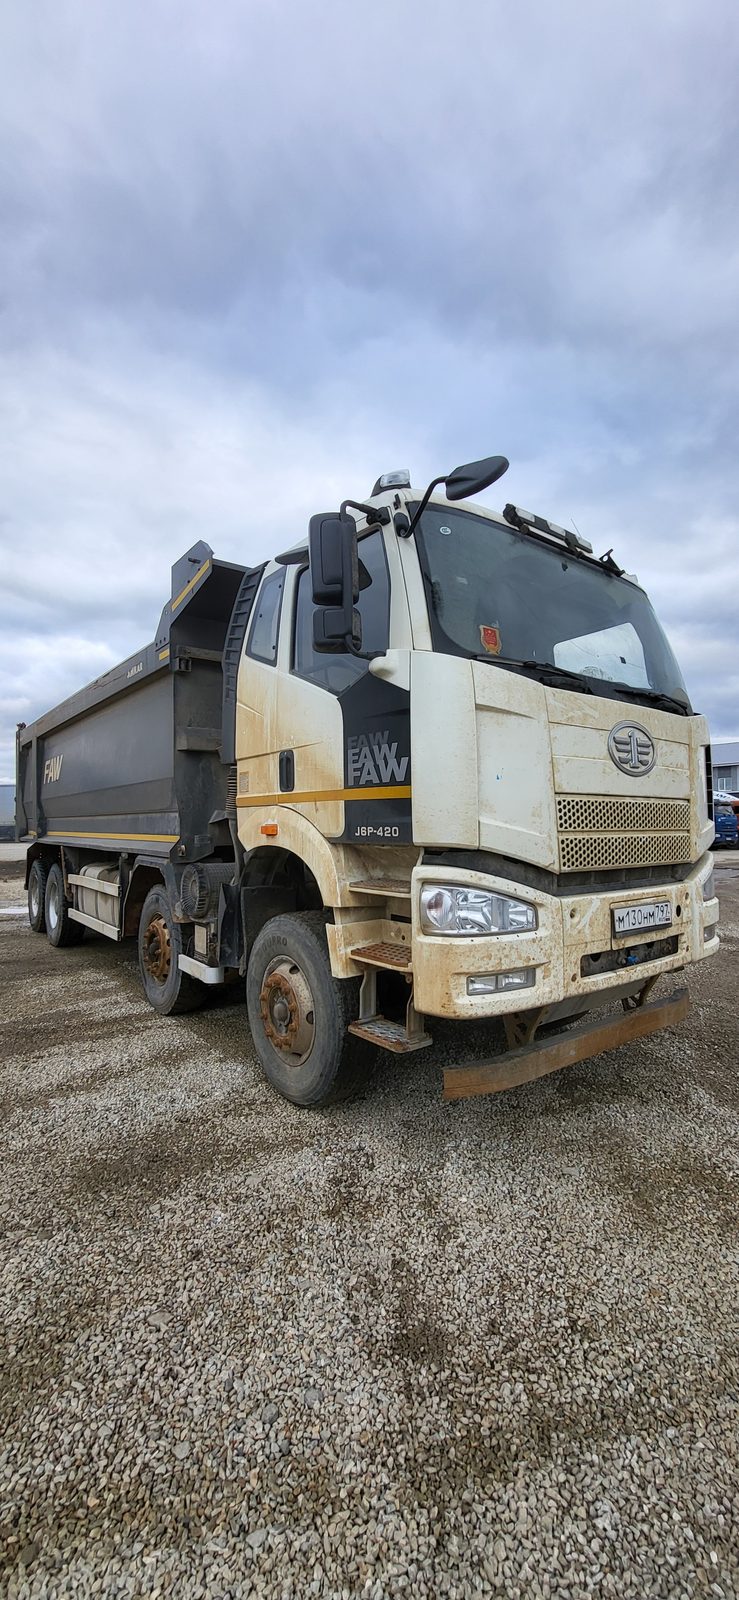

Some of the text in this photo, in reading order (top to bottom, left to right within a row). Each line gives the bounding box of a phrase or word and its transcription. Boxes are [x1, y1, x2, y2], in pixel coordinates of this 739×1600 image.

[348, 731, 389, 750] FAW
[347, 742, 399, 766] FAW
[43, 754, 64, 785] FAW
[347, 756, 409, 786] FAW
[355, 826, 399, 837] J6P-420
